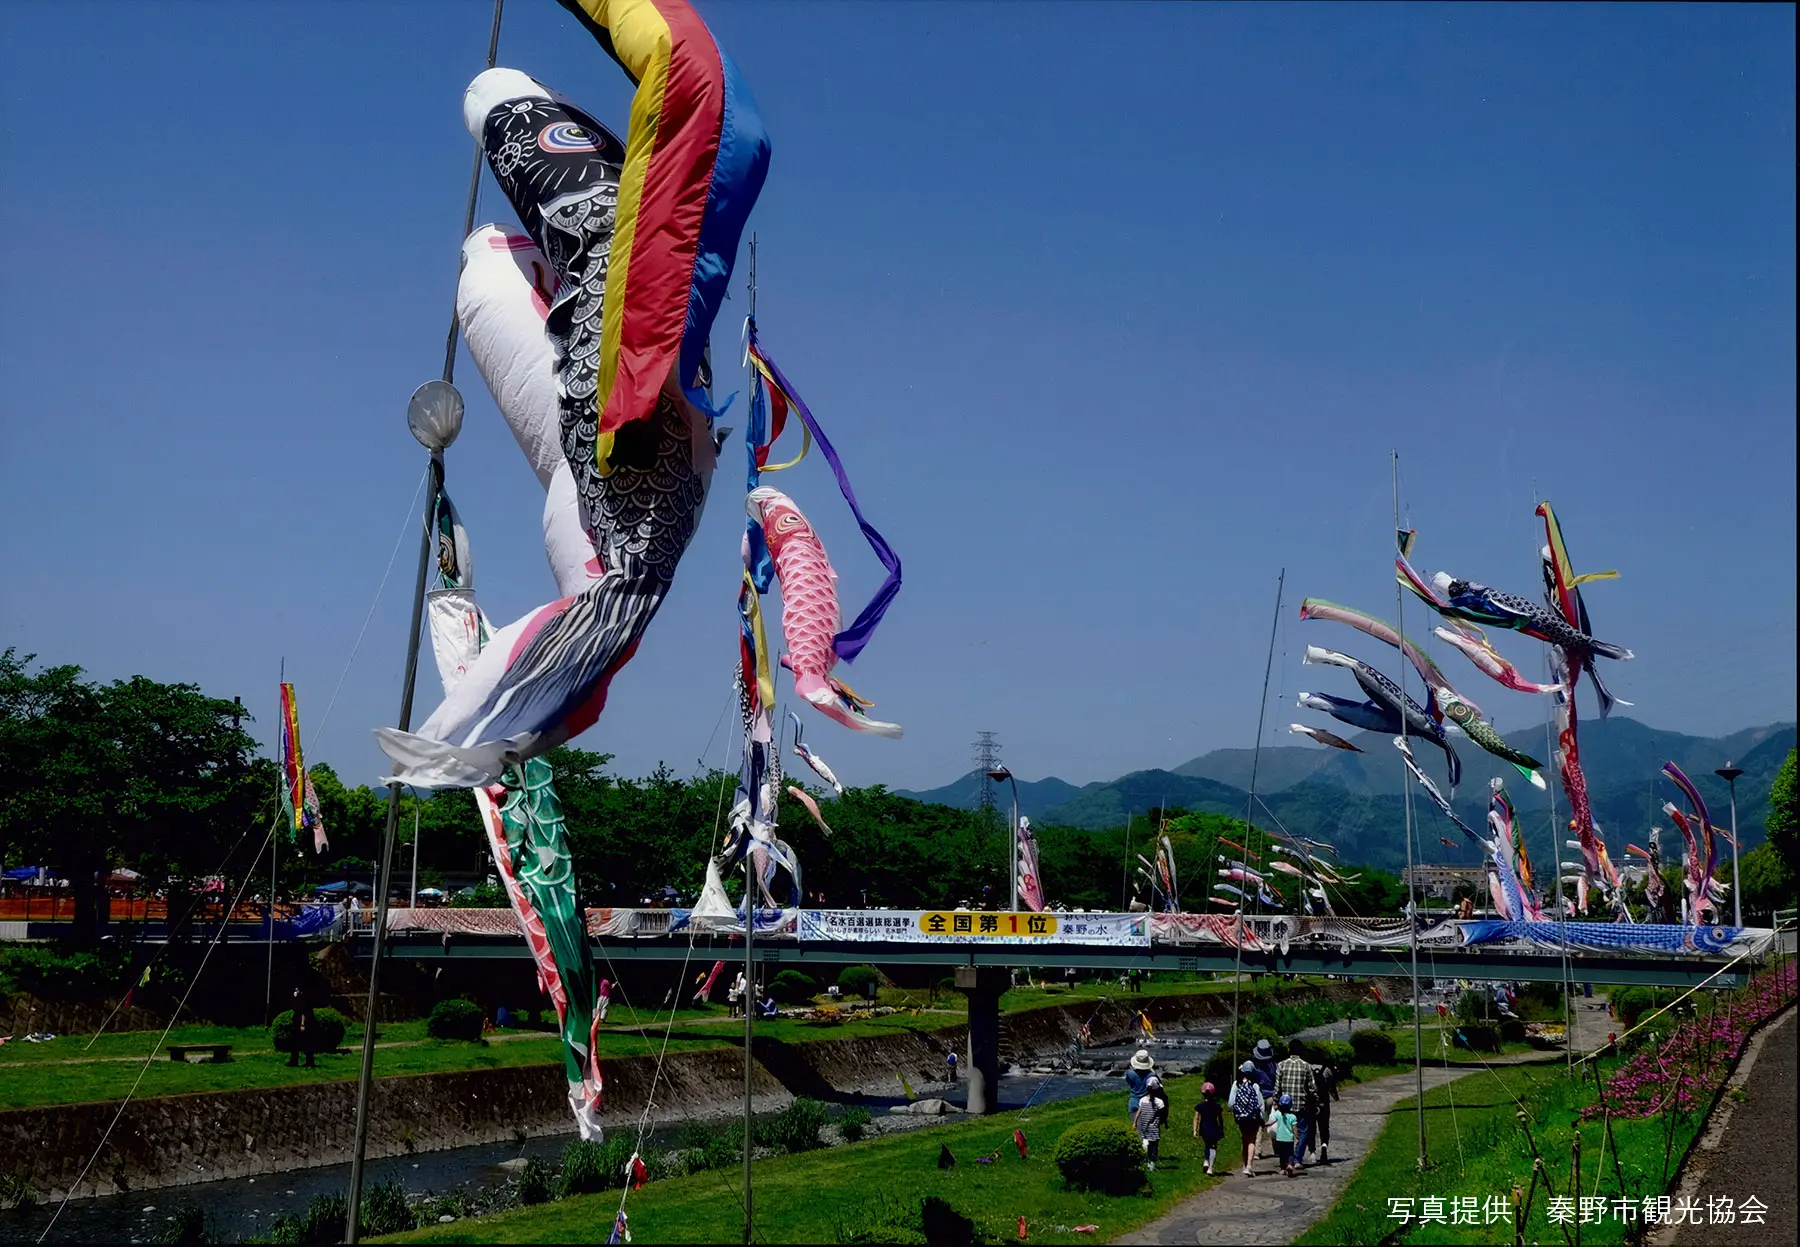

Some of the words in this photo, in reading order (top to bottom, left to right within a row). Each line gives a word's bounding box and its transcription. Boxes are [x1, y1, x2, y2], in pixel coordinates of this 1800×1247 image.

[928, 914, 1047, 934] 全国第1位
[1064, 914, 1104, 922] おいしい
[1063, 923, 1108, 935] 秦野の水
